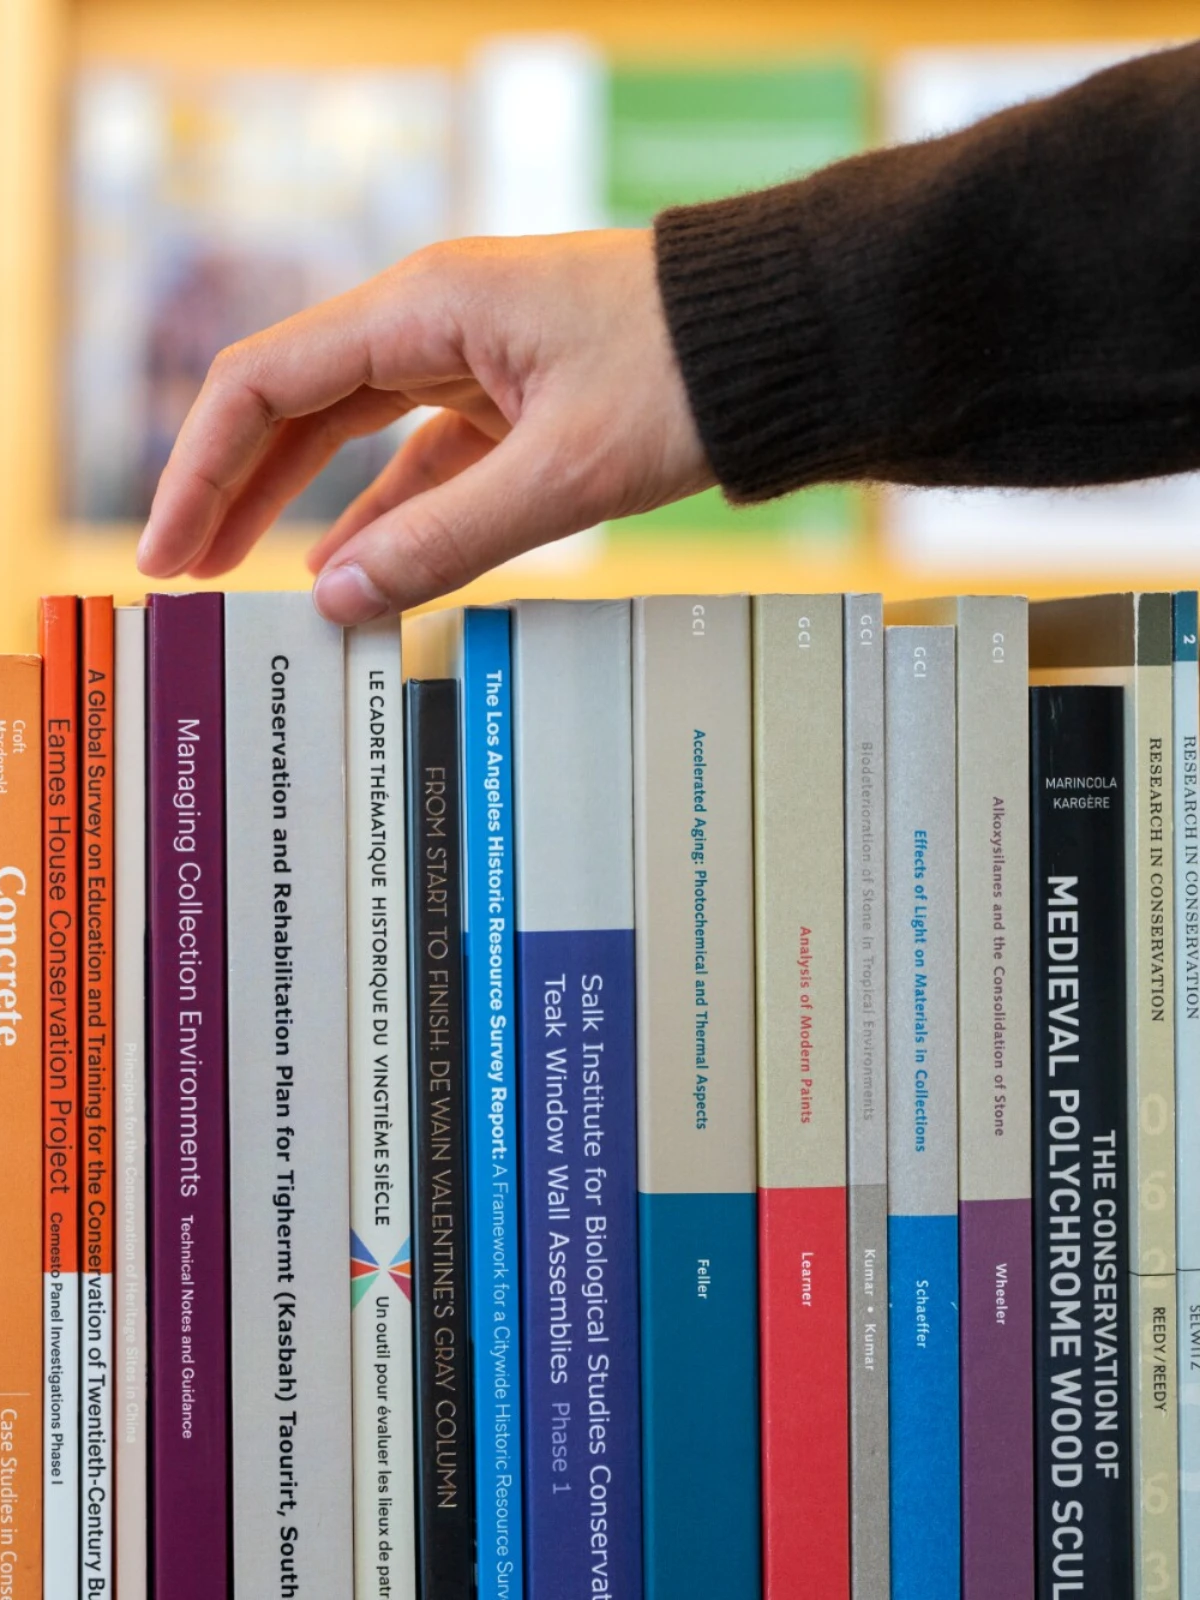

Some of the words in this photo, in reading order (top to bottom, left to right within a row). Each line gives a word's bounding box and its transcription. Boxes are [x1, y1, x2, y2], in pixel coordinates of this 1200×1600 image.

[691, 604, 706, 636] GCI
[797, 615, 811, 649] GCI
[991, 631, 1005, 664] GCI
[369, 670, 385, 691] LE
[485, 669, 503, 707] The
[913, 646, 927, 678] GCI
[12, 719, 27, 754] Croft
[270, 654, 292, 820] Conservation
[369, 695, 385, 760] CADRE
[486, 711, 503, 747] Los
[47, 718, 71, 807] Eames
[172, 719, 202, 853] Managing
[483, 750, 504, 832] Angeles
[1045, 776, 1118, 790] MARINCOLA
[1149, 737, 1163, 842] RESEARCH
[367, 763, 390, 888] THÉMATIQUE
[1053, 794, 1110, 810] KARGÈRE
[48, 816, 72, 901] House
[272, 828, 292, 874] and
[487, 835, 505, 914] Historic
[913, 829, 929, 880] Effects
[989, 796, 1006, 899] Alkoxysilanes
[1150, 847, 1163, 867] IN
[910, 905, 928, 944] Light
[913, 884, 928, 901] of
[992, 903, 1006, 931] and
[178, 862, 204, 1001] Collection
[368, 897, 388, 1014] HISTORIQUE
[488, 917, 506, 1011] Resource
[796, 925, 813, 989] Analysis
[914, 948, 925, 969] on
[992, 935, 1006, 960] the
[1150, 872, 1165, 1022] CONSERVATION
[44, 909, 73, 1090] Conservation
[273, 883, 294, 1056] Rehabilitation
[799, 994, 814, 1010] of
[1047, 875, 1080, 1077] MEDIEVAL
[372, 1019, 389, 1046] DU
[544, 973, 568, 1038] Teak
[913, 973, 929, 1044] Materials
[993, 965, 1007, 1069] Consolidation
[487, 1014, 507, 1082] Survey
[799, 1015, 814, 1073] Modern
[915, 1049, 928, 1064] in
[179, 1011, 203, 1198] Environments
[275, 1065, 294, 1118] Plan
[373, 1054, 393, 1159] VINGTIÈME
[545, 1047, 569, 1154] Window
[799, 1078, 814, 1125] Paints
[914, 1068, 929, 1153] Collections
[993, 1074, 1007, 1090] of
[44, 1100, 73, 1194] Project
[276, 1125, 295, 1163] for
[487, 1086, 508, 1160] Report:
[993, 1094, 1007, 1137] Stone
[547, 1164, 571, 1220] Wall
[1092, 1129, 1117, 1190] THE
[272, 1169, 296, 1283] Tighermt
[374, 1163, 394, 1226] SIÈCLE
[1048, 1089, 1082, 1358] POLYCHROME
[180, 1214, 195, 1286] Technical
[697, 1259, 711, 1299] Feller
[801, 1251, 814, 1307] Learner
[181, 1289, 195, 1333] Notes
[548, 1231, 573, 1384] Assemblies
[915, 1279, 930, 1349] Schaeffer
[995, 1263, 1009, 1325] Wheeler
[1092, 1198, 1119, 1431] CONSERVATION
[181, 1335, 196, 1364] and
[273, 1291, 298, 1402] (Kasbah)
[181, 1367, 196, 1439] Guidance
[1050, 1367, 1083, 1488] WOOD
[276, 1410, 299, 1517] Taourirt,
[551, 1402, 572, 1472] Phase
[1094, 1440, 1120, 1480] OF
[552, 1482, 572, 1495] 1
[279, 1526, 300, 1599] South
